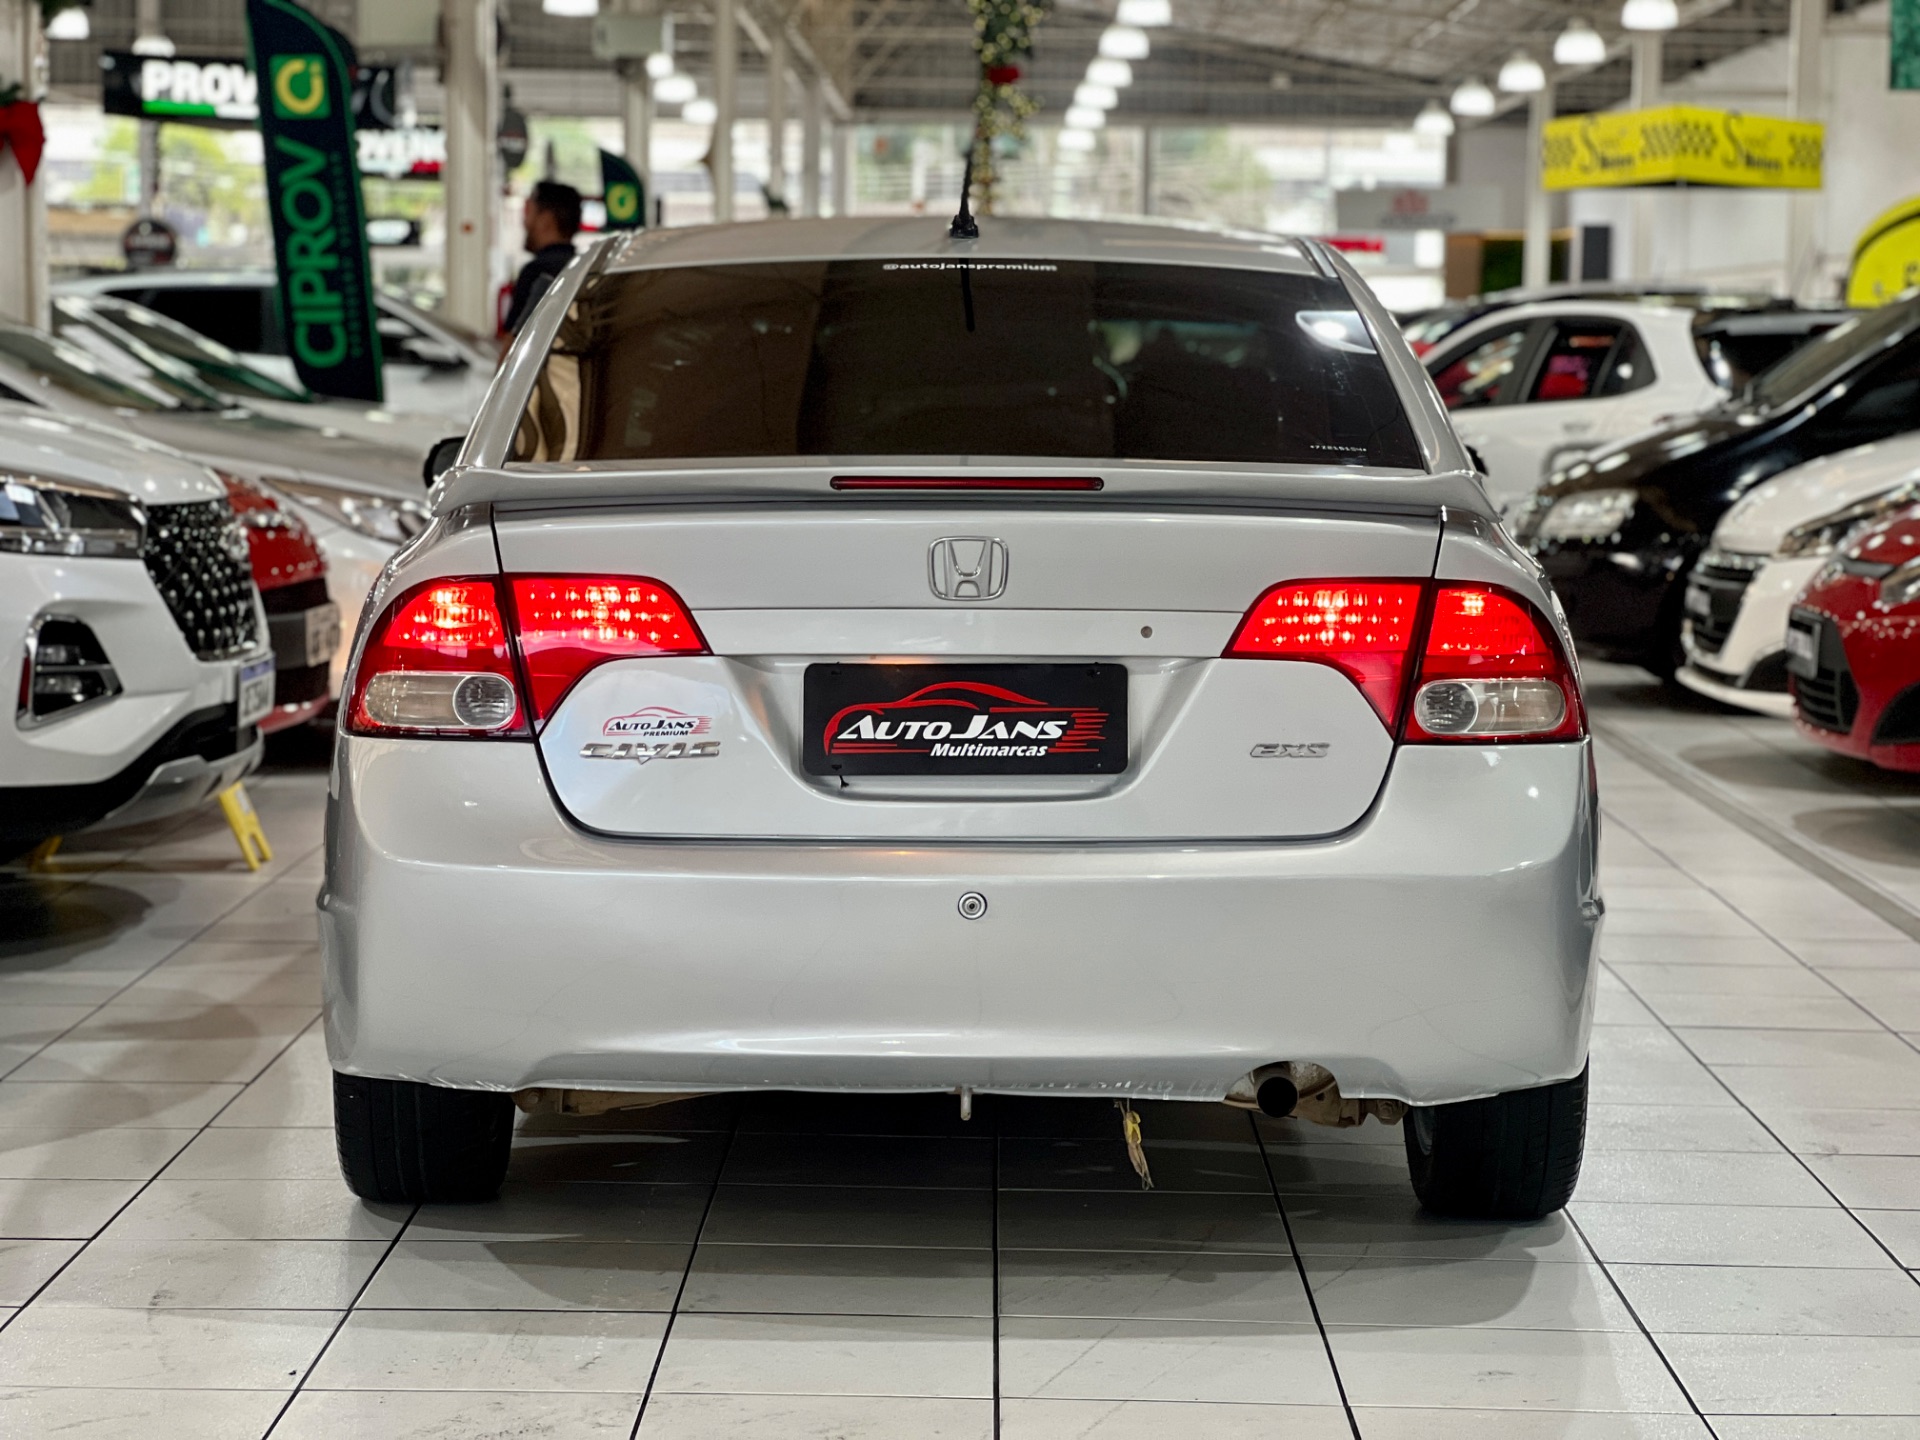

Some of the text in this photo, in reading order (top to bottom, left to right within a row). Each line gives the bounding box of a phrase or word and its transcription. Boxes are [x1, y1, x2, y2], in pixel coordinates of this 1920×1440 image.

[274, 134, 348, 368] CIPROV
[882, 262, 1058, 271] @autojanspremium
[579, 741, 721, 765] CIVIC
[929, 743, 1049, 758] Multimarcas
[1249, 743, 1330, 758] EXS
